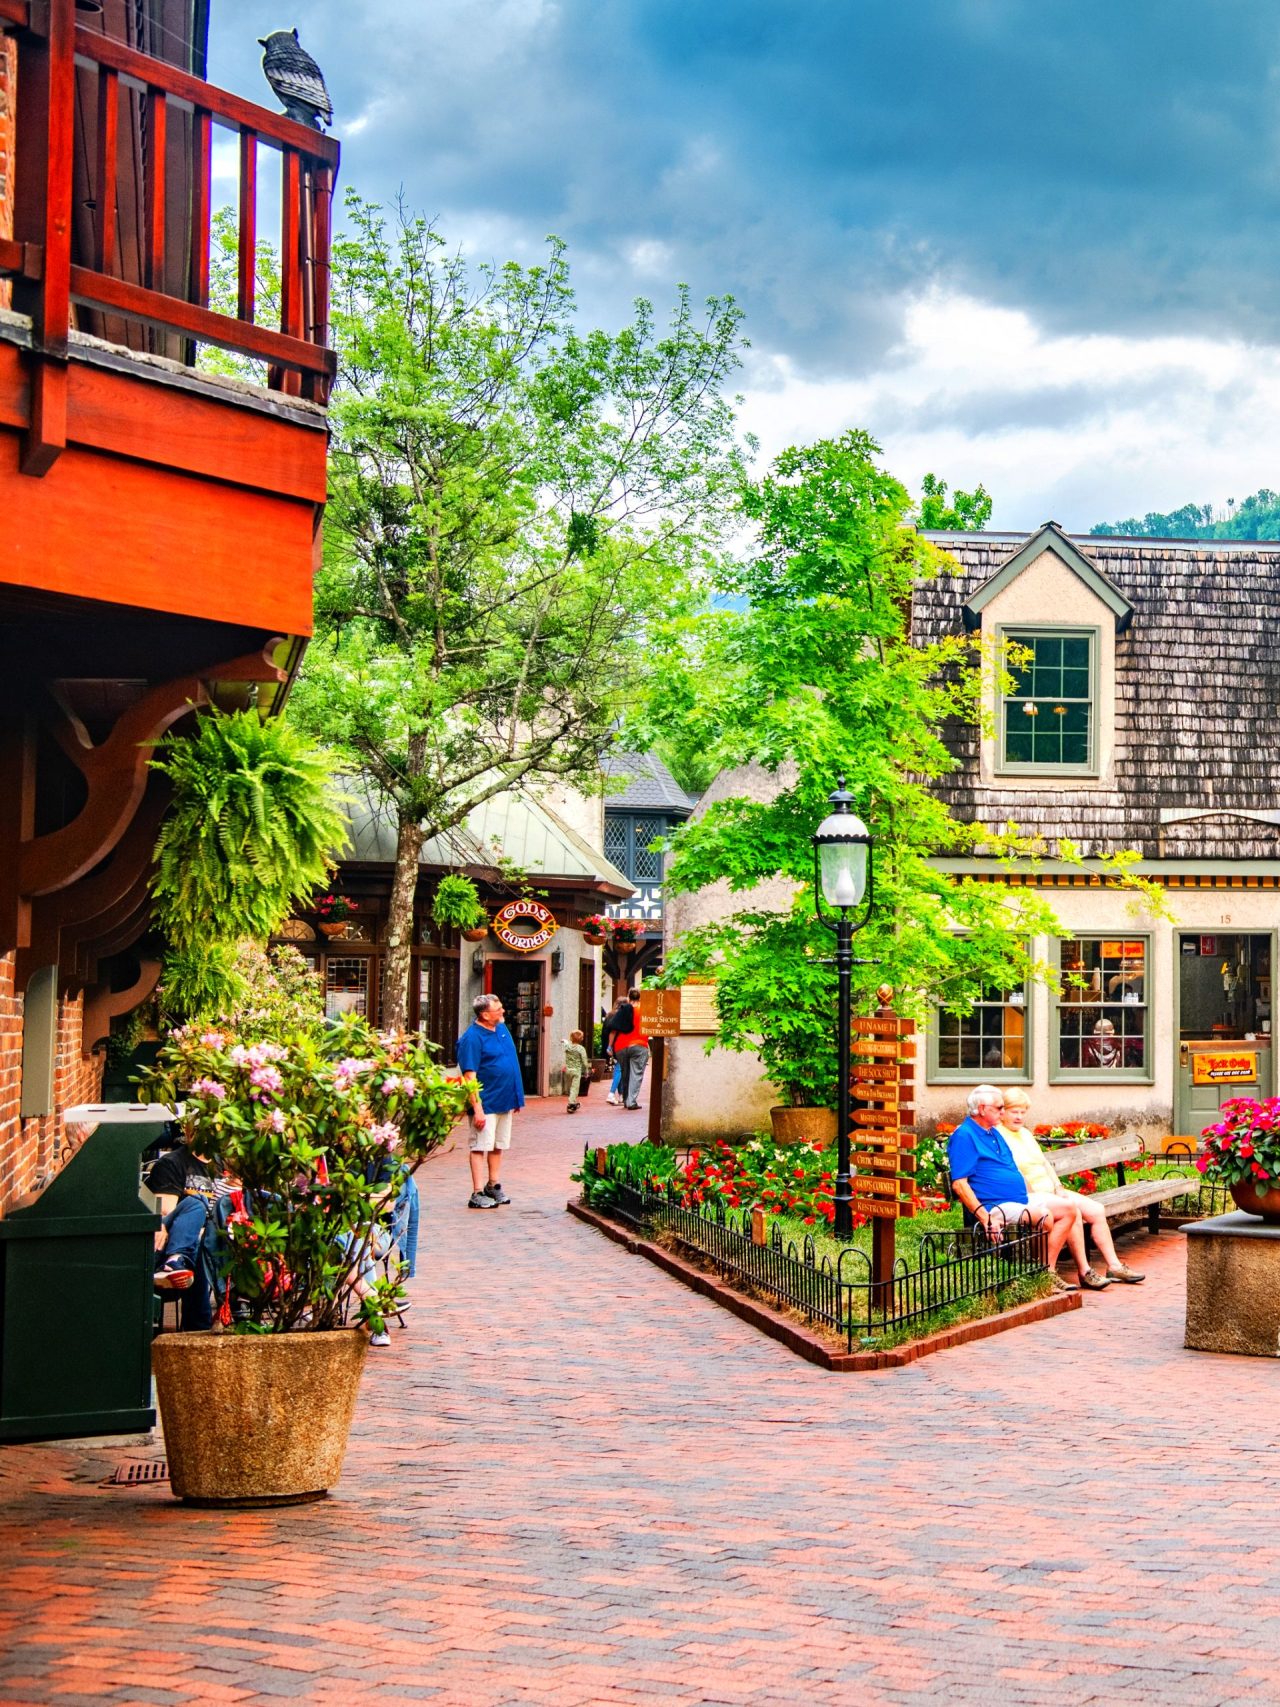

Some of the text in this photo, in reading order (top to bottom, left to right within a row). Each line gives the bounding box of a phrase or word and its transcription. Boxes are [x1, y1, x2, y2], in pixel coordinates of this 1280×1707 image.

[504, 902, 550, 921] GODS
[1220, 915, 1231, 924] 15
[502, 930, 552, 948] CORNER
[657, 1006, 663, 1015] 8
[867, 1022, 888, 1031] NAME
[890, 1023, 896, 1032] IT
[859, 1066, 895, 1078] THE SOCK SHOP
[858, 1202, 896, 1215] RESTROOMS
